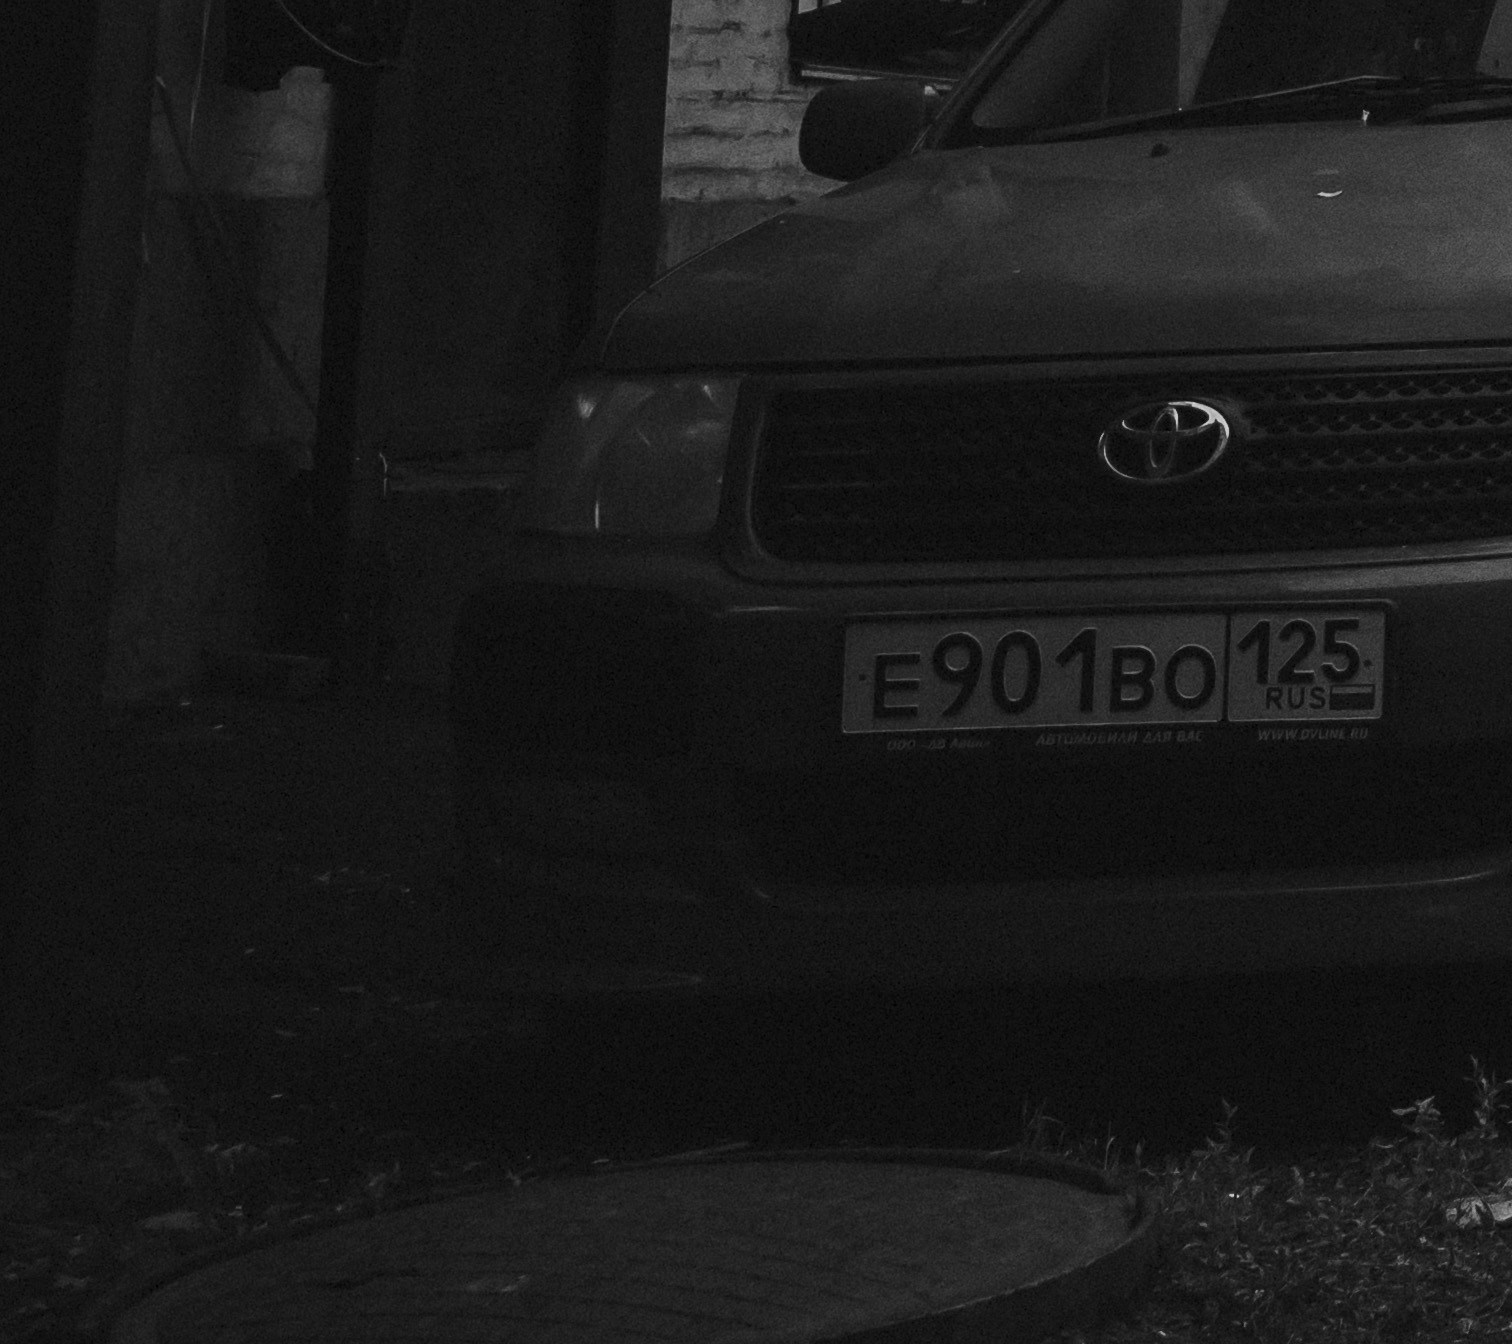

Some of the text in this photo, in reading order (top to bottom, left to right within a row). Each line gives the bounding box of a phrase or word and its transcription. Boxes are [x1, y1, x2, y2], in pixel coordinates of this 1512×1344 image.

[872, 617, 1362, 719] Е901ВО 125
[1265, 686, 1327, 710] RUS
